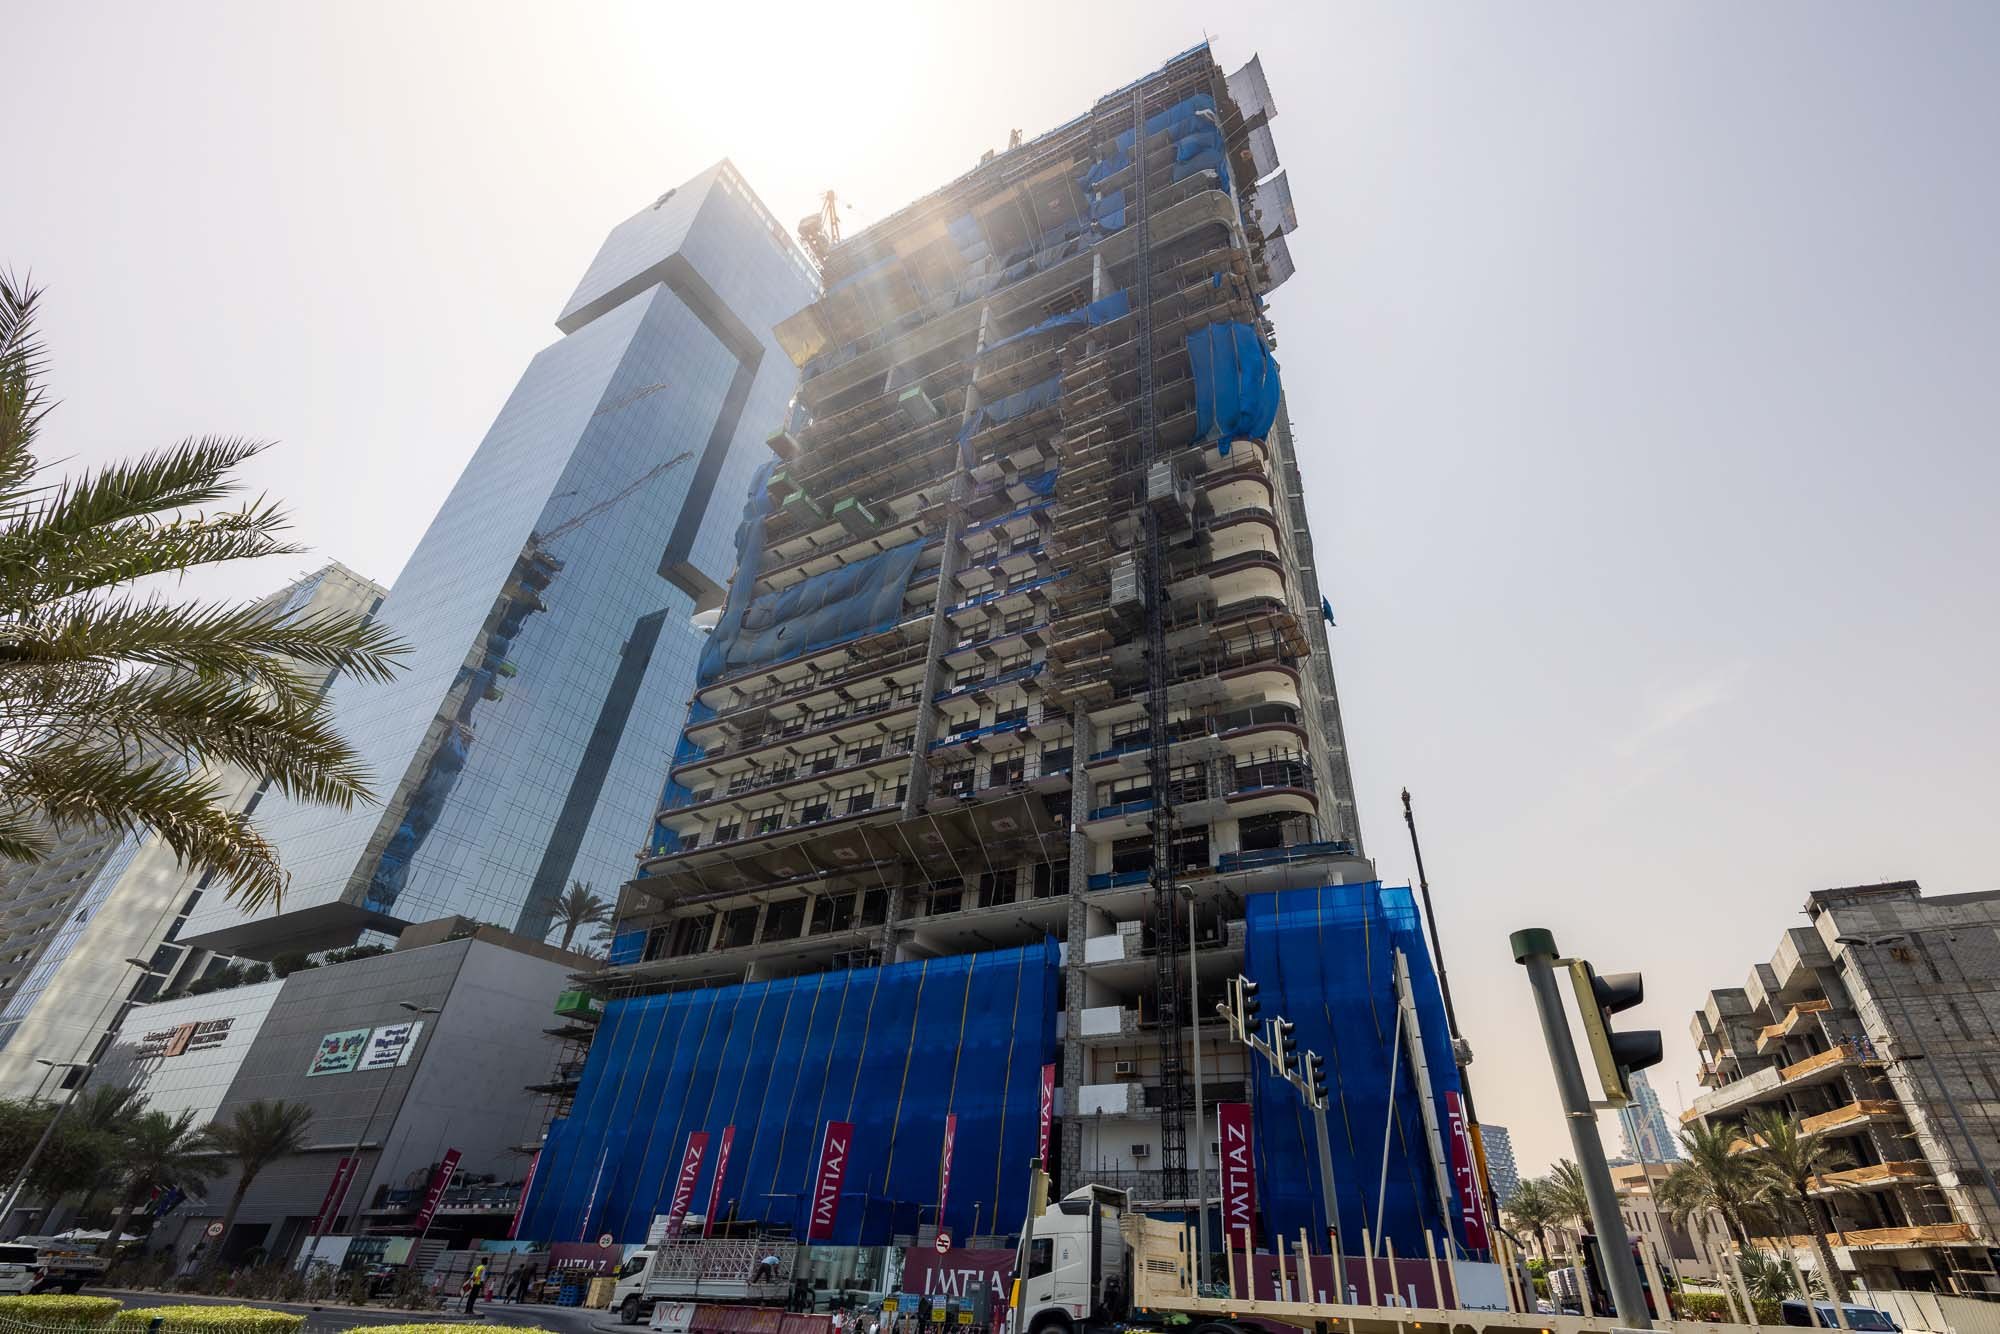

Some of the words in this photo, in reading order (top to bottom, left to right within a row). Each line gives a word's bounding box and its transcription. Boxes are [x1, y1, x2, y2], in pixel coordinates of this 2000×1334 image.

[671, 1146, 702, 1222] IMTIAZ
[816, 1138, 847, 1225] IMTIAZ
[1228, 1123, 1250, 1229] IMTIAZ
